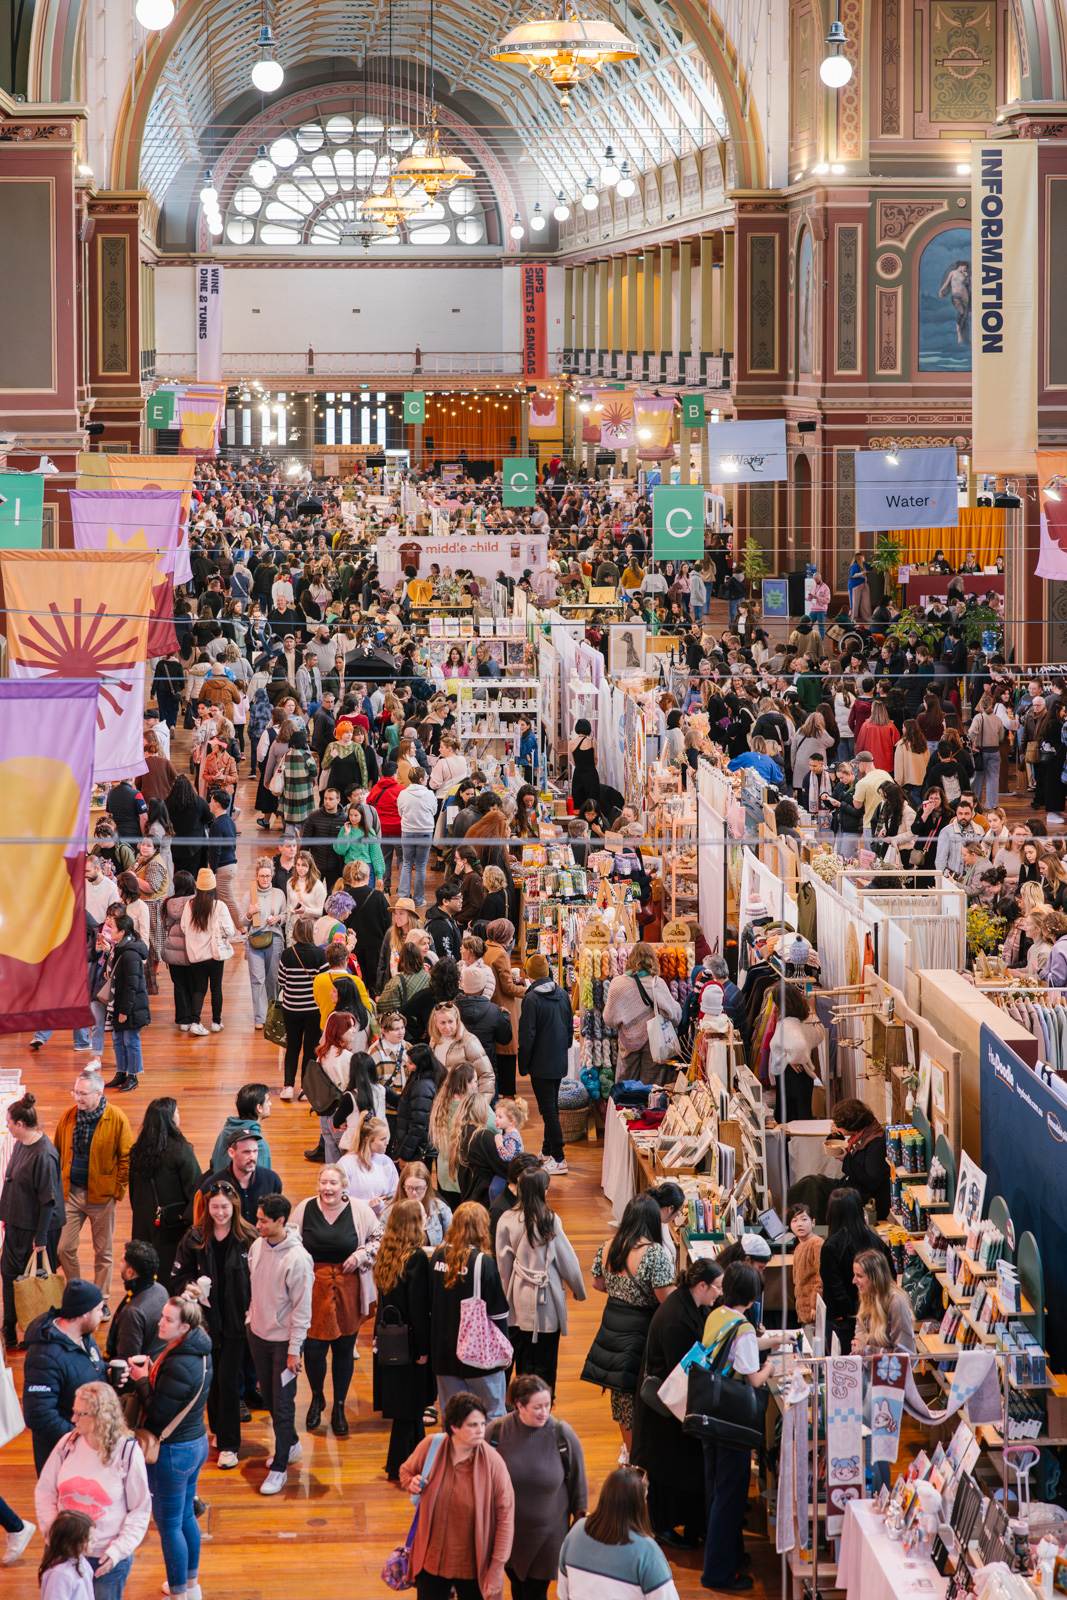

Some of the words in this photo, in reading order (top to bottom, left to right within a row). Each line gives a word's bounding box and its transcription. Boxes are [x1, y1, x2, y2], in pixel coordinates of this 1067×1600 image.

[981, 149, 1003, 353] INFORMATION
[200, 268, 208, 292] DINE
[210, 268, 219, 294] WINE
[525, 267, 535, 312] SWEETS
[535, 267, 544, 294] SIPS
[199, 294, 208, 302] &
[199, 306, 207, 340] TUNES
[526, 315, 536, 324] &
[526, 327, 536, 374] SANGAS
[154, 406, 164, 420] E
[408, 402, 420, 414] C
[689, 405, 700, 418] B
[511, 472, 528, 492] C
[666, 508, 692, 538] C
[426, 542, 467, 554] middle
[470, 542, 498, 552] child
[832, 1358, 858, 1399] egg
